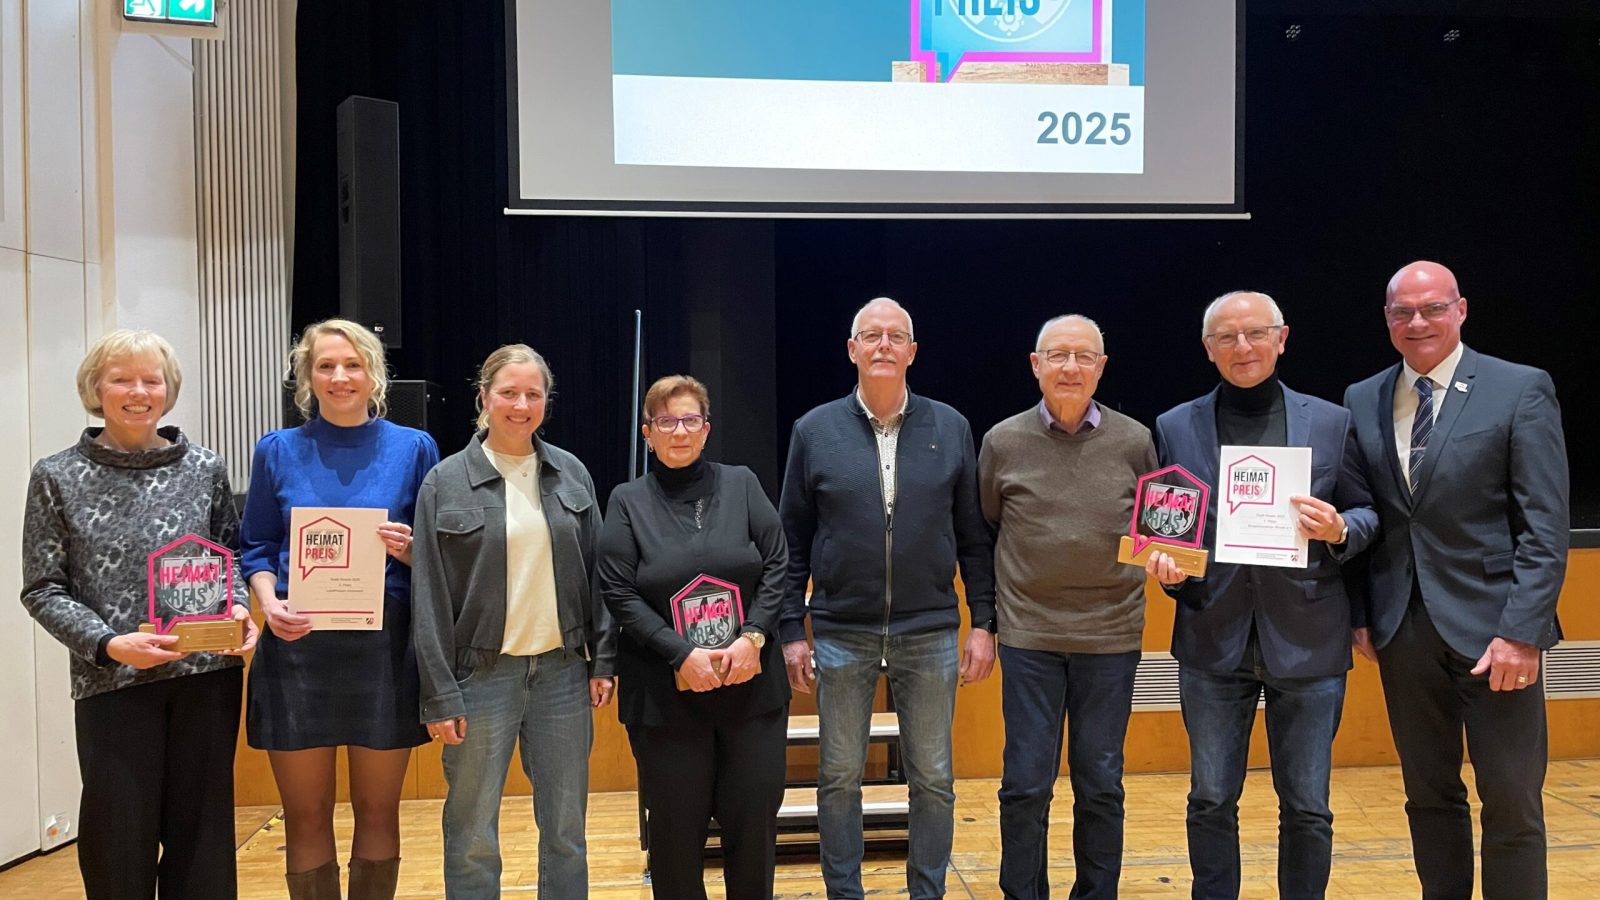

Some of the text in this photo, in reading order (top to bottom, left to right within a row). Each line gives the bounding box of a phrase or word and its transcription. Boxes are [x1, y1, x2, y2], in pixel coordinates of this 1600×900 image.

[1037, 111, 1131, 145] 2025
[1234, 471, 1269, 483] HEIMAT
[1233, 483, 1260, 496] PREIS
[1144, 489, 1197, 513] HEIMAT
[1141, 508, 1182, 530] PREIS
[306, 534, 344, 545] HEIMAT
[305, 547, 335, 560] PREIS
[159, 563, 219, 584] HEIMAT
[160, 586, 207, 605] PREIS
[684, 599, 732, 625] HEIMAT
